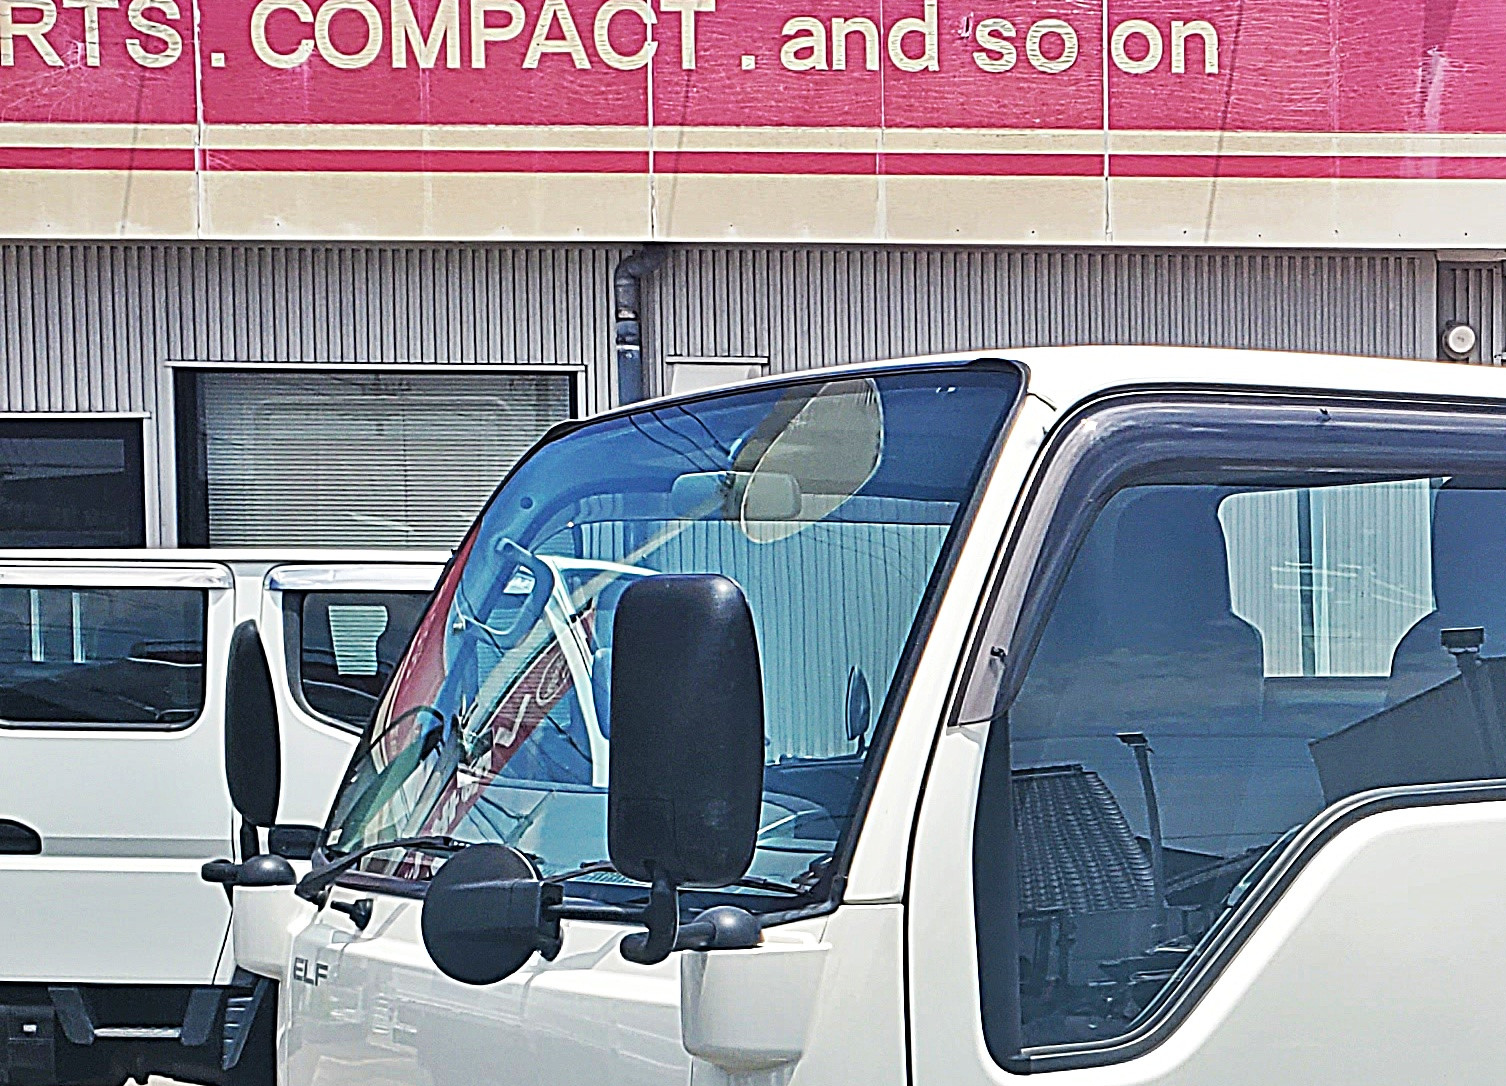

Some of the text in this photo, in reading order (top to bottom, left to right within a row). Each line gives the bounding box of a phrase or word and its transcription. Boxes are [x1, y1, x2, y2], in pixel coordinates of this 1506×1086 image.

[972, 18, 1080, 75] so
[1110, 19, 1220, 75] on
[292, 956, 329, 987] ELF
